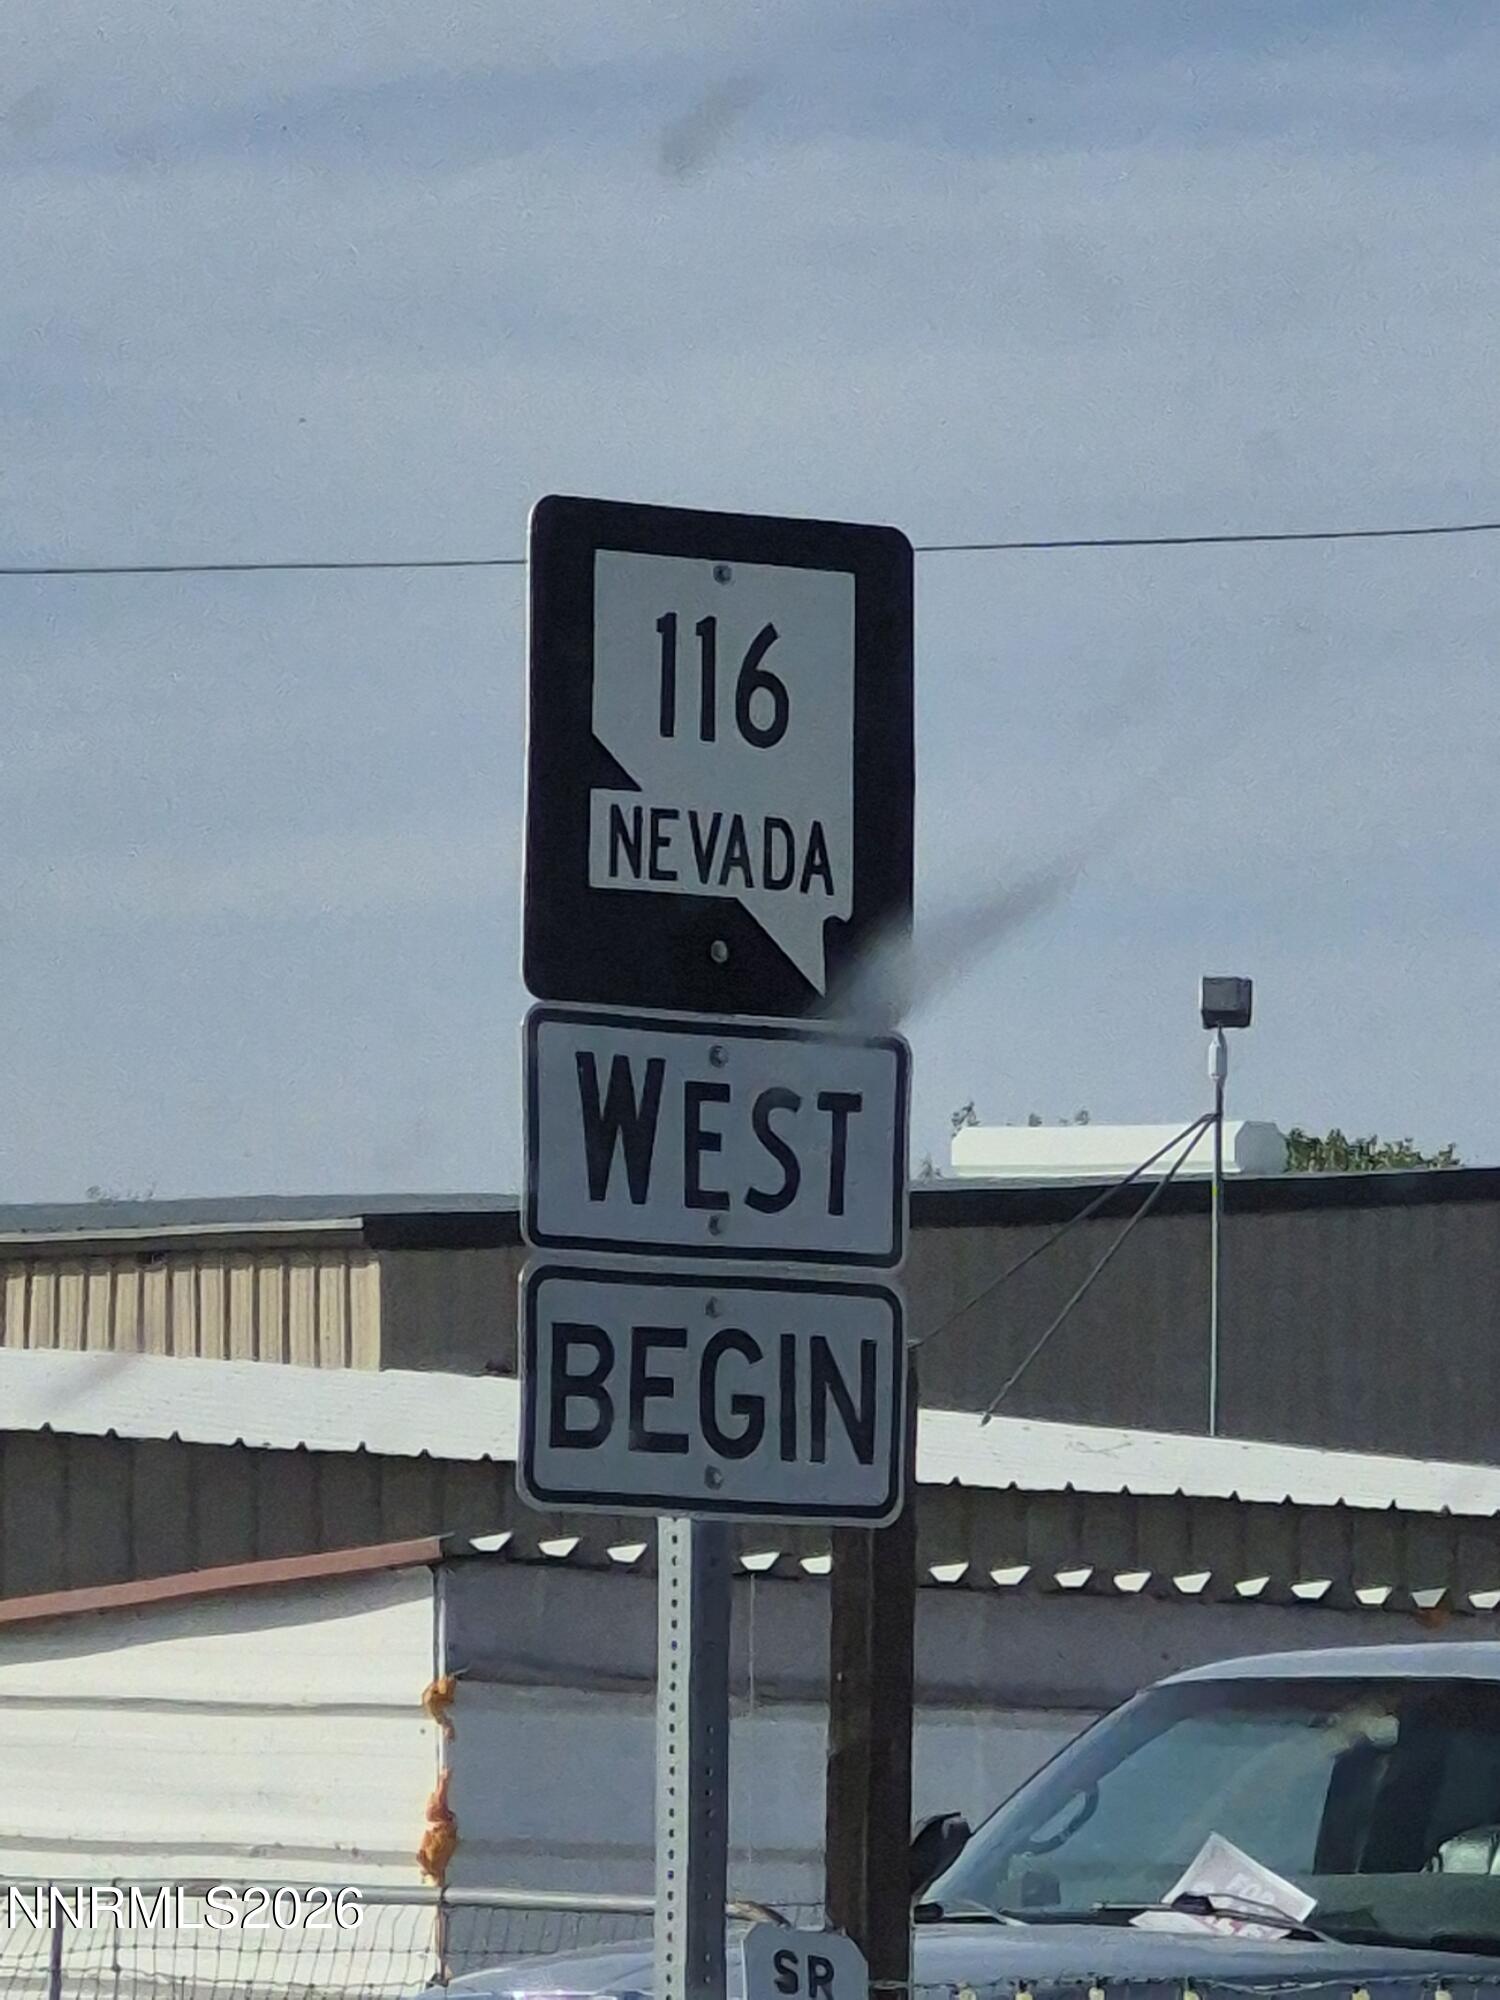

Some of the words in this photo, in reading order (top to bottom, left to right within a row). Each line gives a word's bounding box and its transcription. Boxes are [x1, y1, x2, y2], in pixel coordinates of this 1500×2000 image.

[656, 611, 790, 749] 116
[608, 803, 835, 897] NEVADA
[576, 1051, 863, 1216] WEST
[549, 1322, 877, 1466] BEGIN
[773, 1949, 835, 2000] SR
